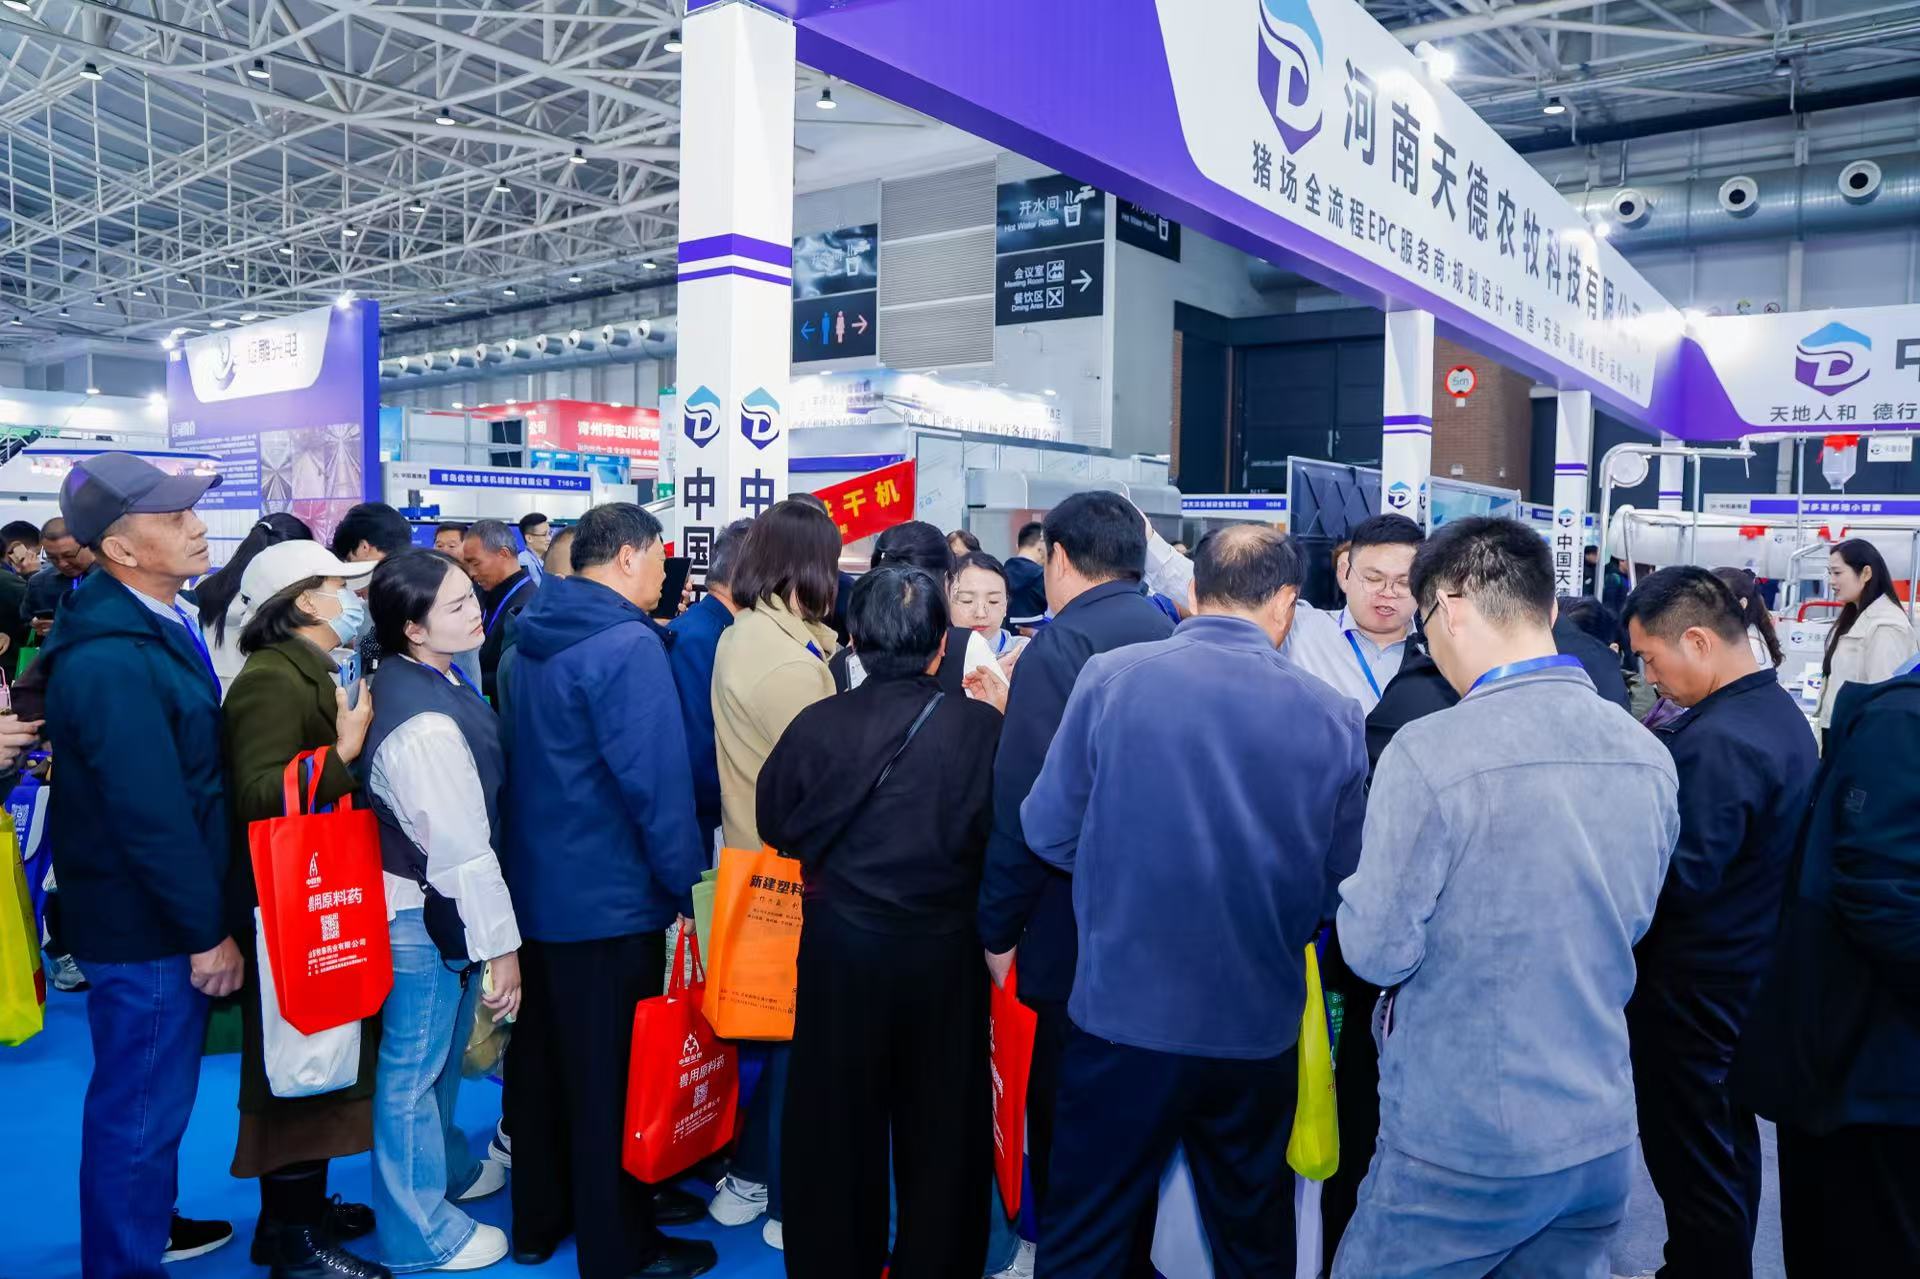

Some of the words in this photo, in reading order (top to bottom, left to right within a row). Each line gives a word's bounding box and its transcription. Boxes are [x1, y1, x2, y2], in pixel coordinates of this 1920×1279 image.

[1019, 195, 1060, 216] 开水间
[1004, 222, 1016, 232] Hot
[1017, 219, 1037, 230] Water
[1038, 217, 1059, 228] Room
[1014, 265, 1045, 280] 会议室
[1004, 279, 1026, 289] Meeting
[1027, 277, 1045, 286] Room
[1014, 290, 1044, 305] 餐饮区
[1030, 302, 1044, 310] Area
[1451, 376, 1470, 387] 5m
[1770, 404, 1857, 422] 天地人和
[1872, 402, 1918, 421] 德行
[683, 467, 715, 601] 中国
[680, 1053, 725, 1088] 兽用原料药
